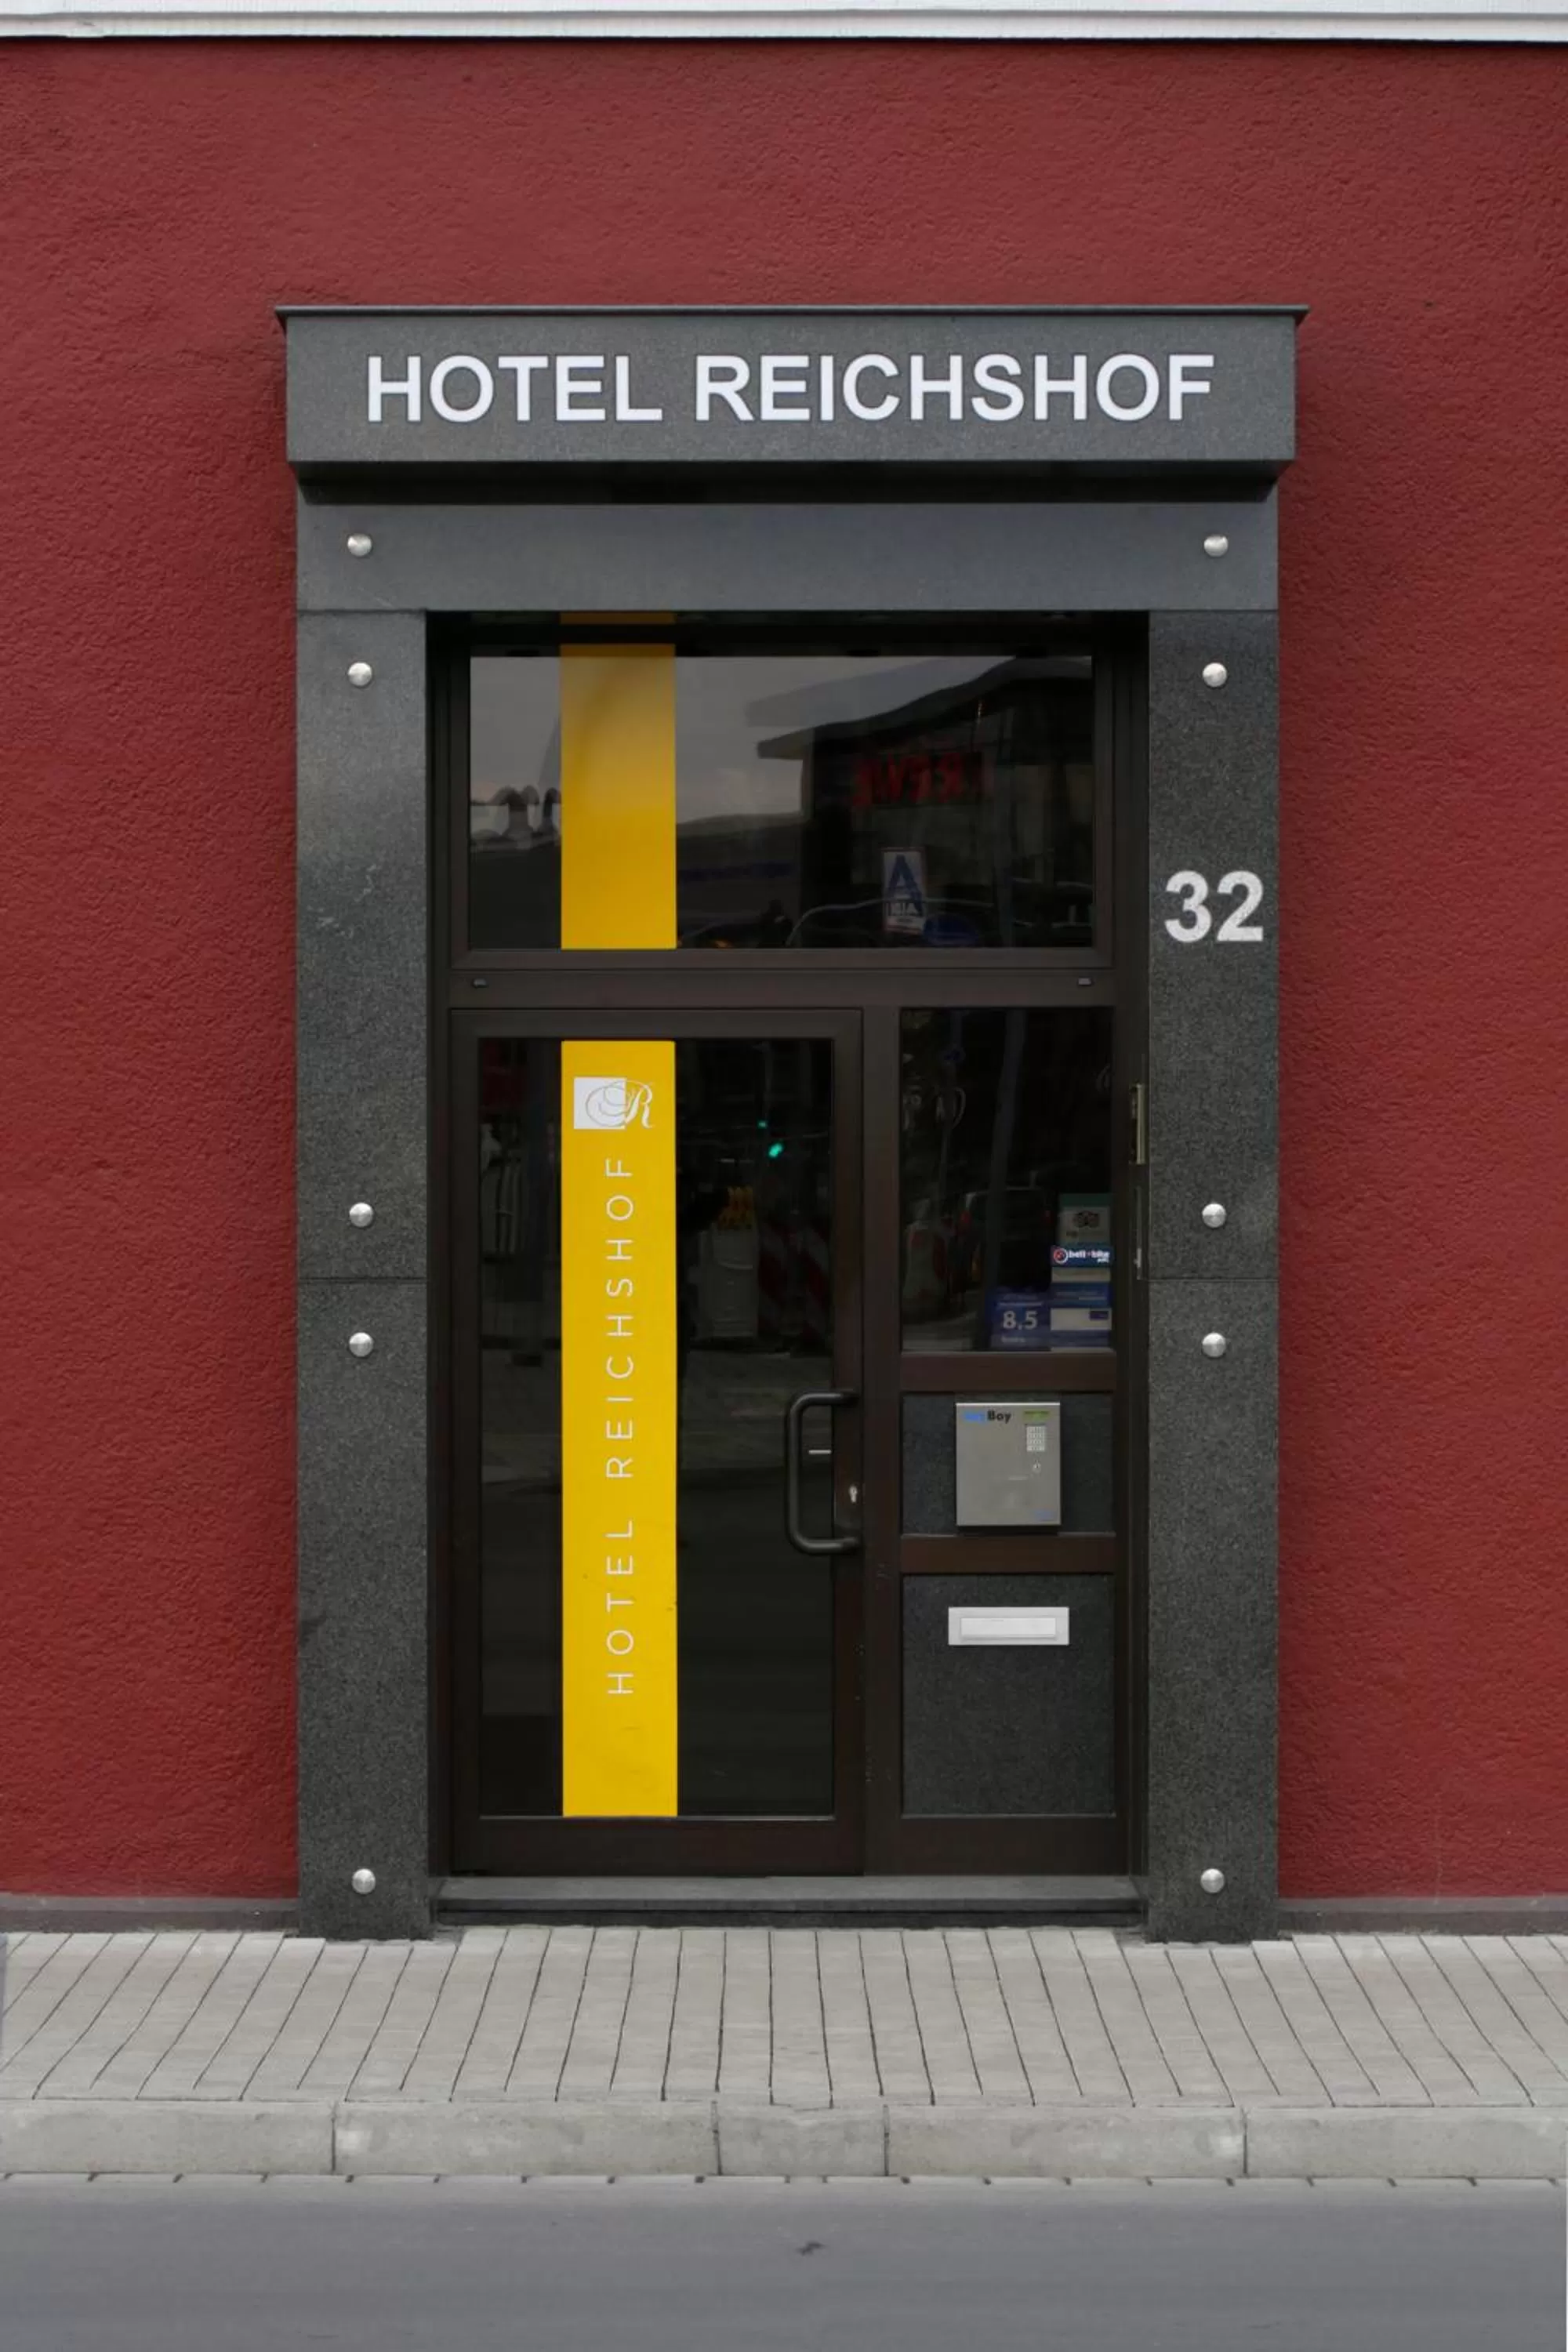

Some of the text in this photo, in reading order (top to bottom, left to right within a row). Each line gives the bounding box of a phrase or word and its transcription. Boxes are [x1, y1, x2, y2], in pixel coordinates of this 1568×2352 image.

[368, 354, 1214, 423] HOTEL REICHSHOF
[1164, 870, 1264, 943] 32
[1003, 1310, 1038, 1330] 8.5
[604, 1157, 635, 1695] HOTEL REICHSHOF
